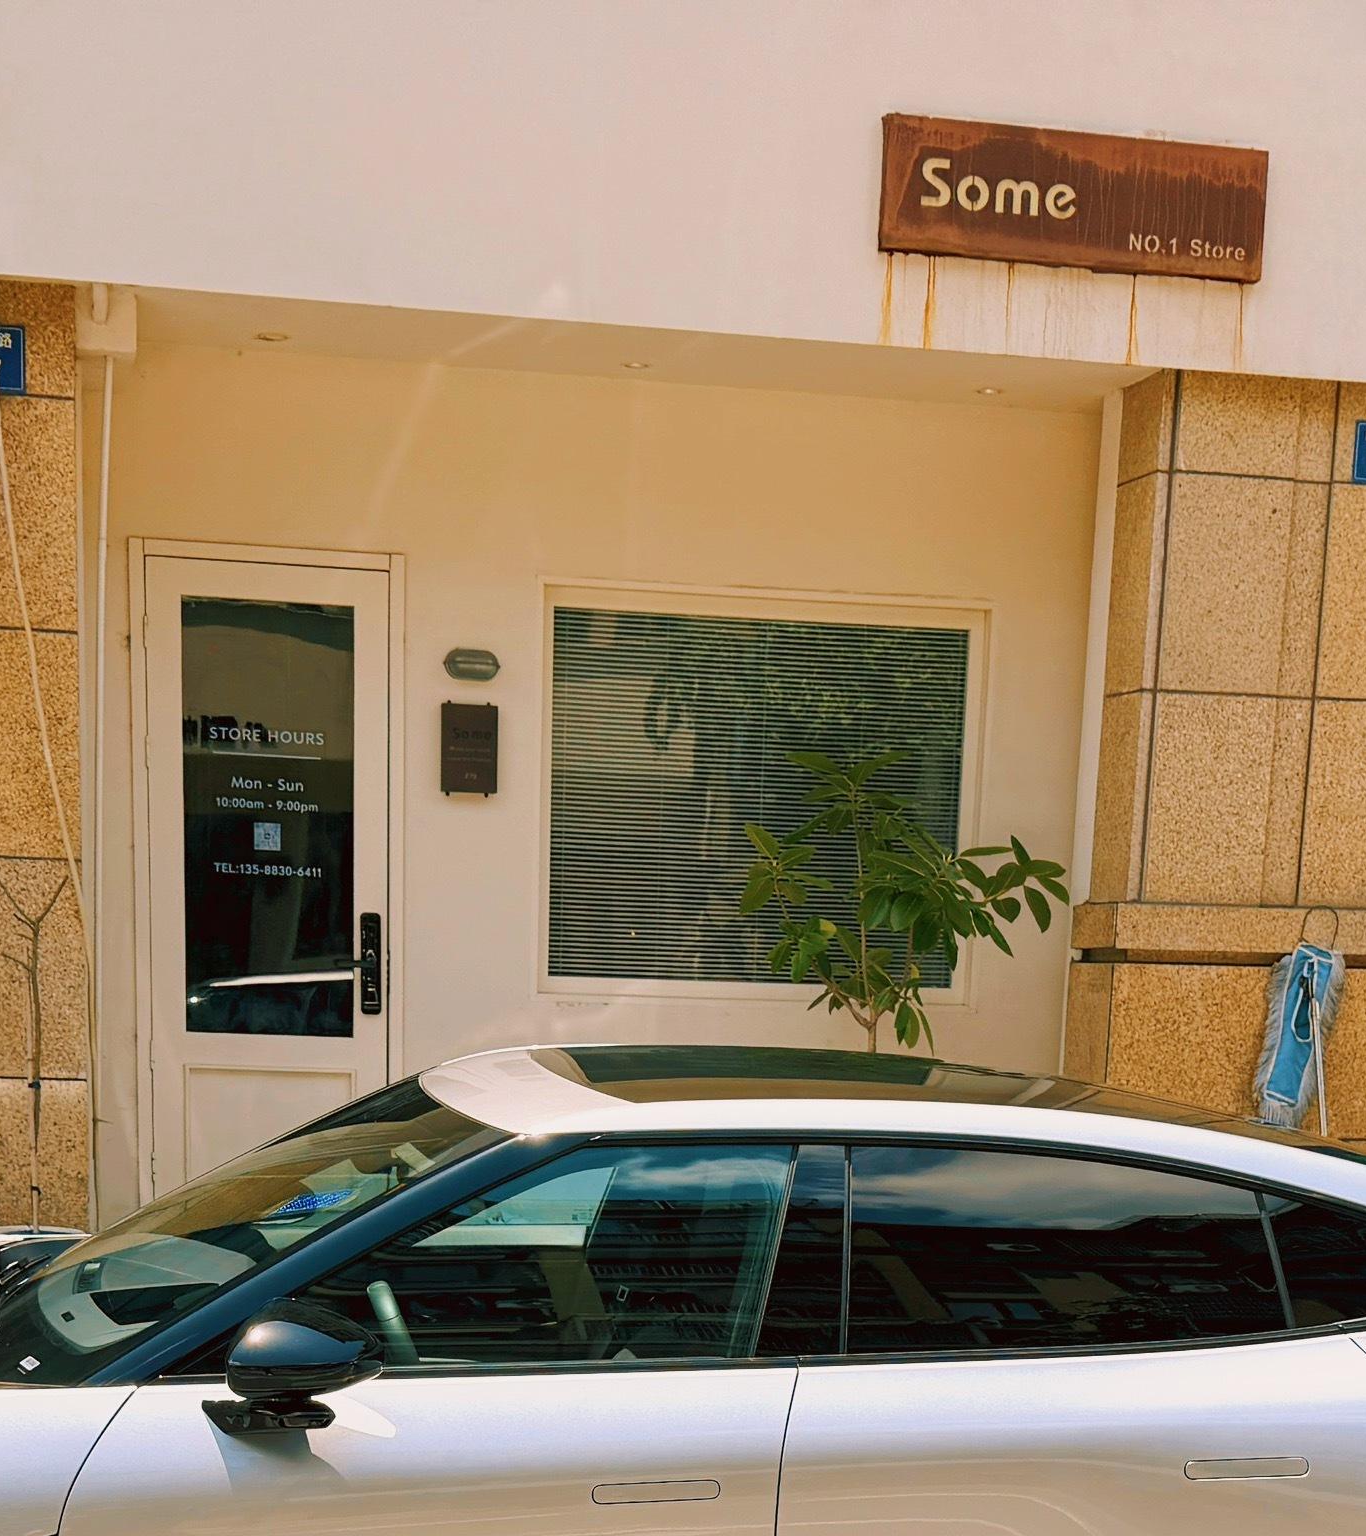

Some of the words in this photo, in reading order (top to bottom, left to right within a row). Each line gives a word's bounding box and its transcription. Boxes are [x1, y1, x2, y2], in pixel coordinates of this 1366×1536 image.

[920, 157, 1077, 220] Some
[1129, 233, 1177, 256] NO.1
[1190, 238, 1246, 261] Store
[209, 727, 262, 742] STORE
[268, 730, 324, 746] HOURS
[231, 776, 262, 790] Mon
[277, 779, 304, 792] Sun
[216, 797, 264, 809] 10:00am
[276, 801, 319, 813] 9:00pm
